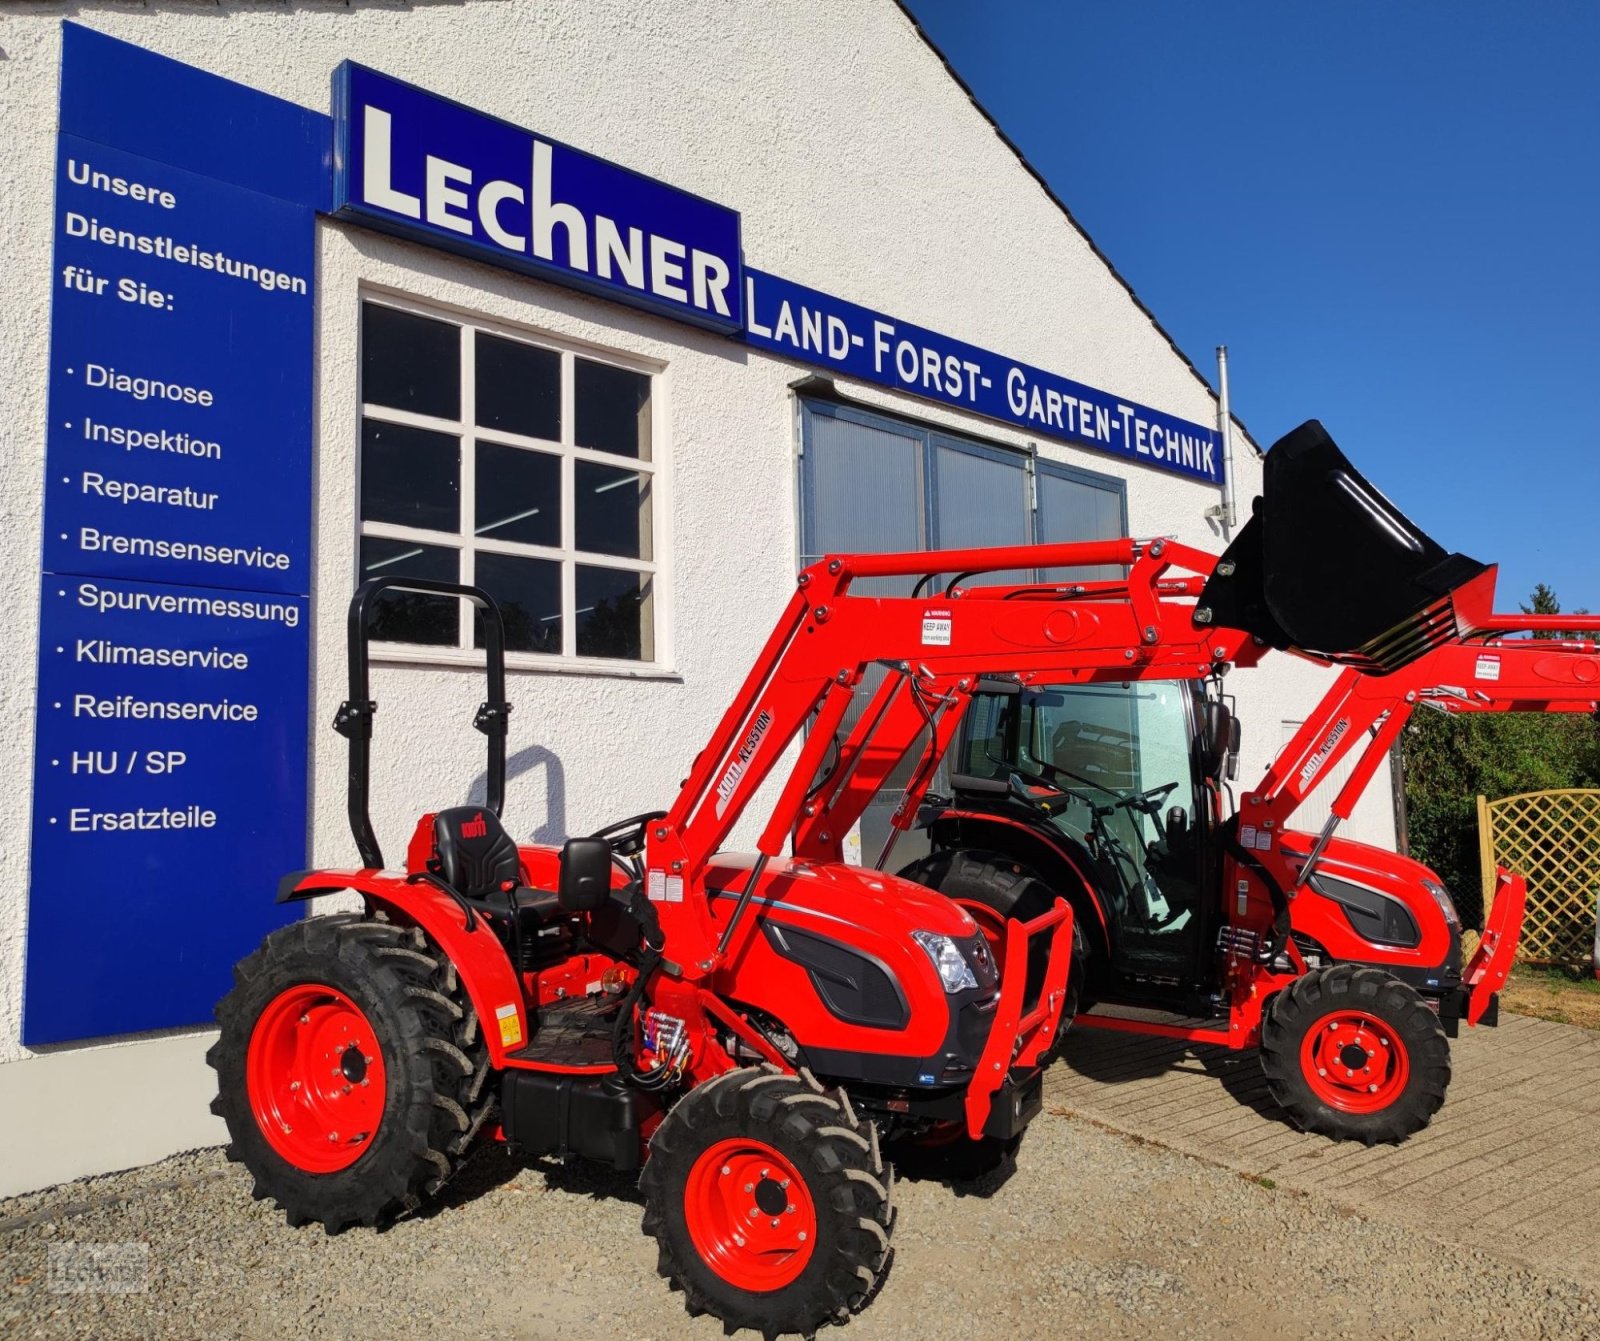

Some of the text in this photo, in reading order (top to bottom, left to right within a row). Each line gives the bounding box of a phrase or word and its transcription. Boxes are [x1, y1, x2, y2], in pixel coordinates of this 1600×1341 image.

[68, 159, 176, 209] Unsere
[66, 211, 307, 295] Dienstleistungen
[62, 265, 174, 311] für Sie:
[86, 363, 214, 407] Diagnose
[746, 276, 1216, 475] LAND- FORST- GARTEN-TECHNIK
[85, 417, 221, 460] Inspektion
[83, 471, 219, 510] Reparatur
[80, 527, 290, 570] Bremsenservice
[78, 583, 299, 627] Spurvermessung
[76, 639, 248, 670] Klimaservice
[74, 694, 258, 722] Reifenservice
[738, 710, 771, 764] KL5510N
[72, 751, 187, 774] HU / SP
[70, 805, 217, 832] Ersatzteile
